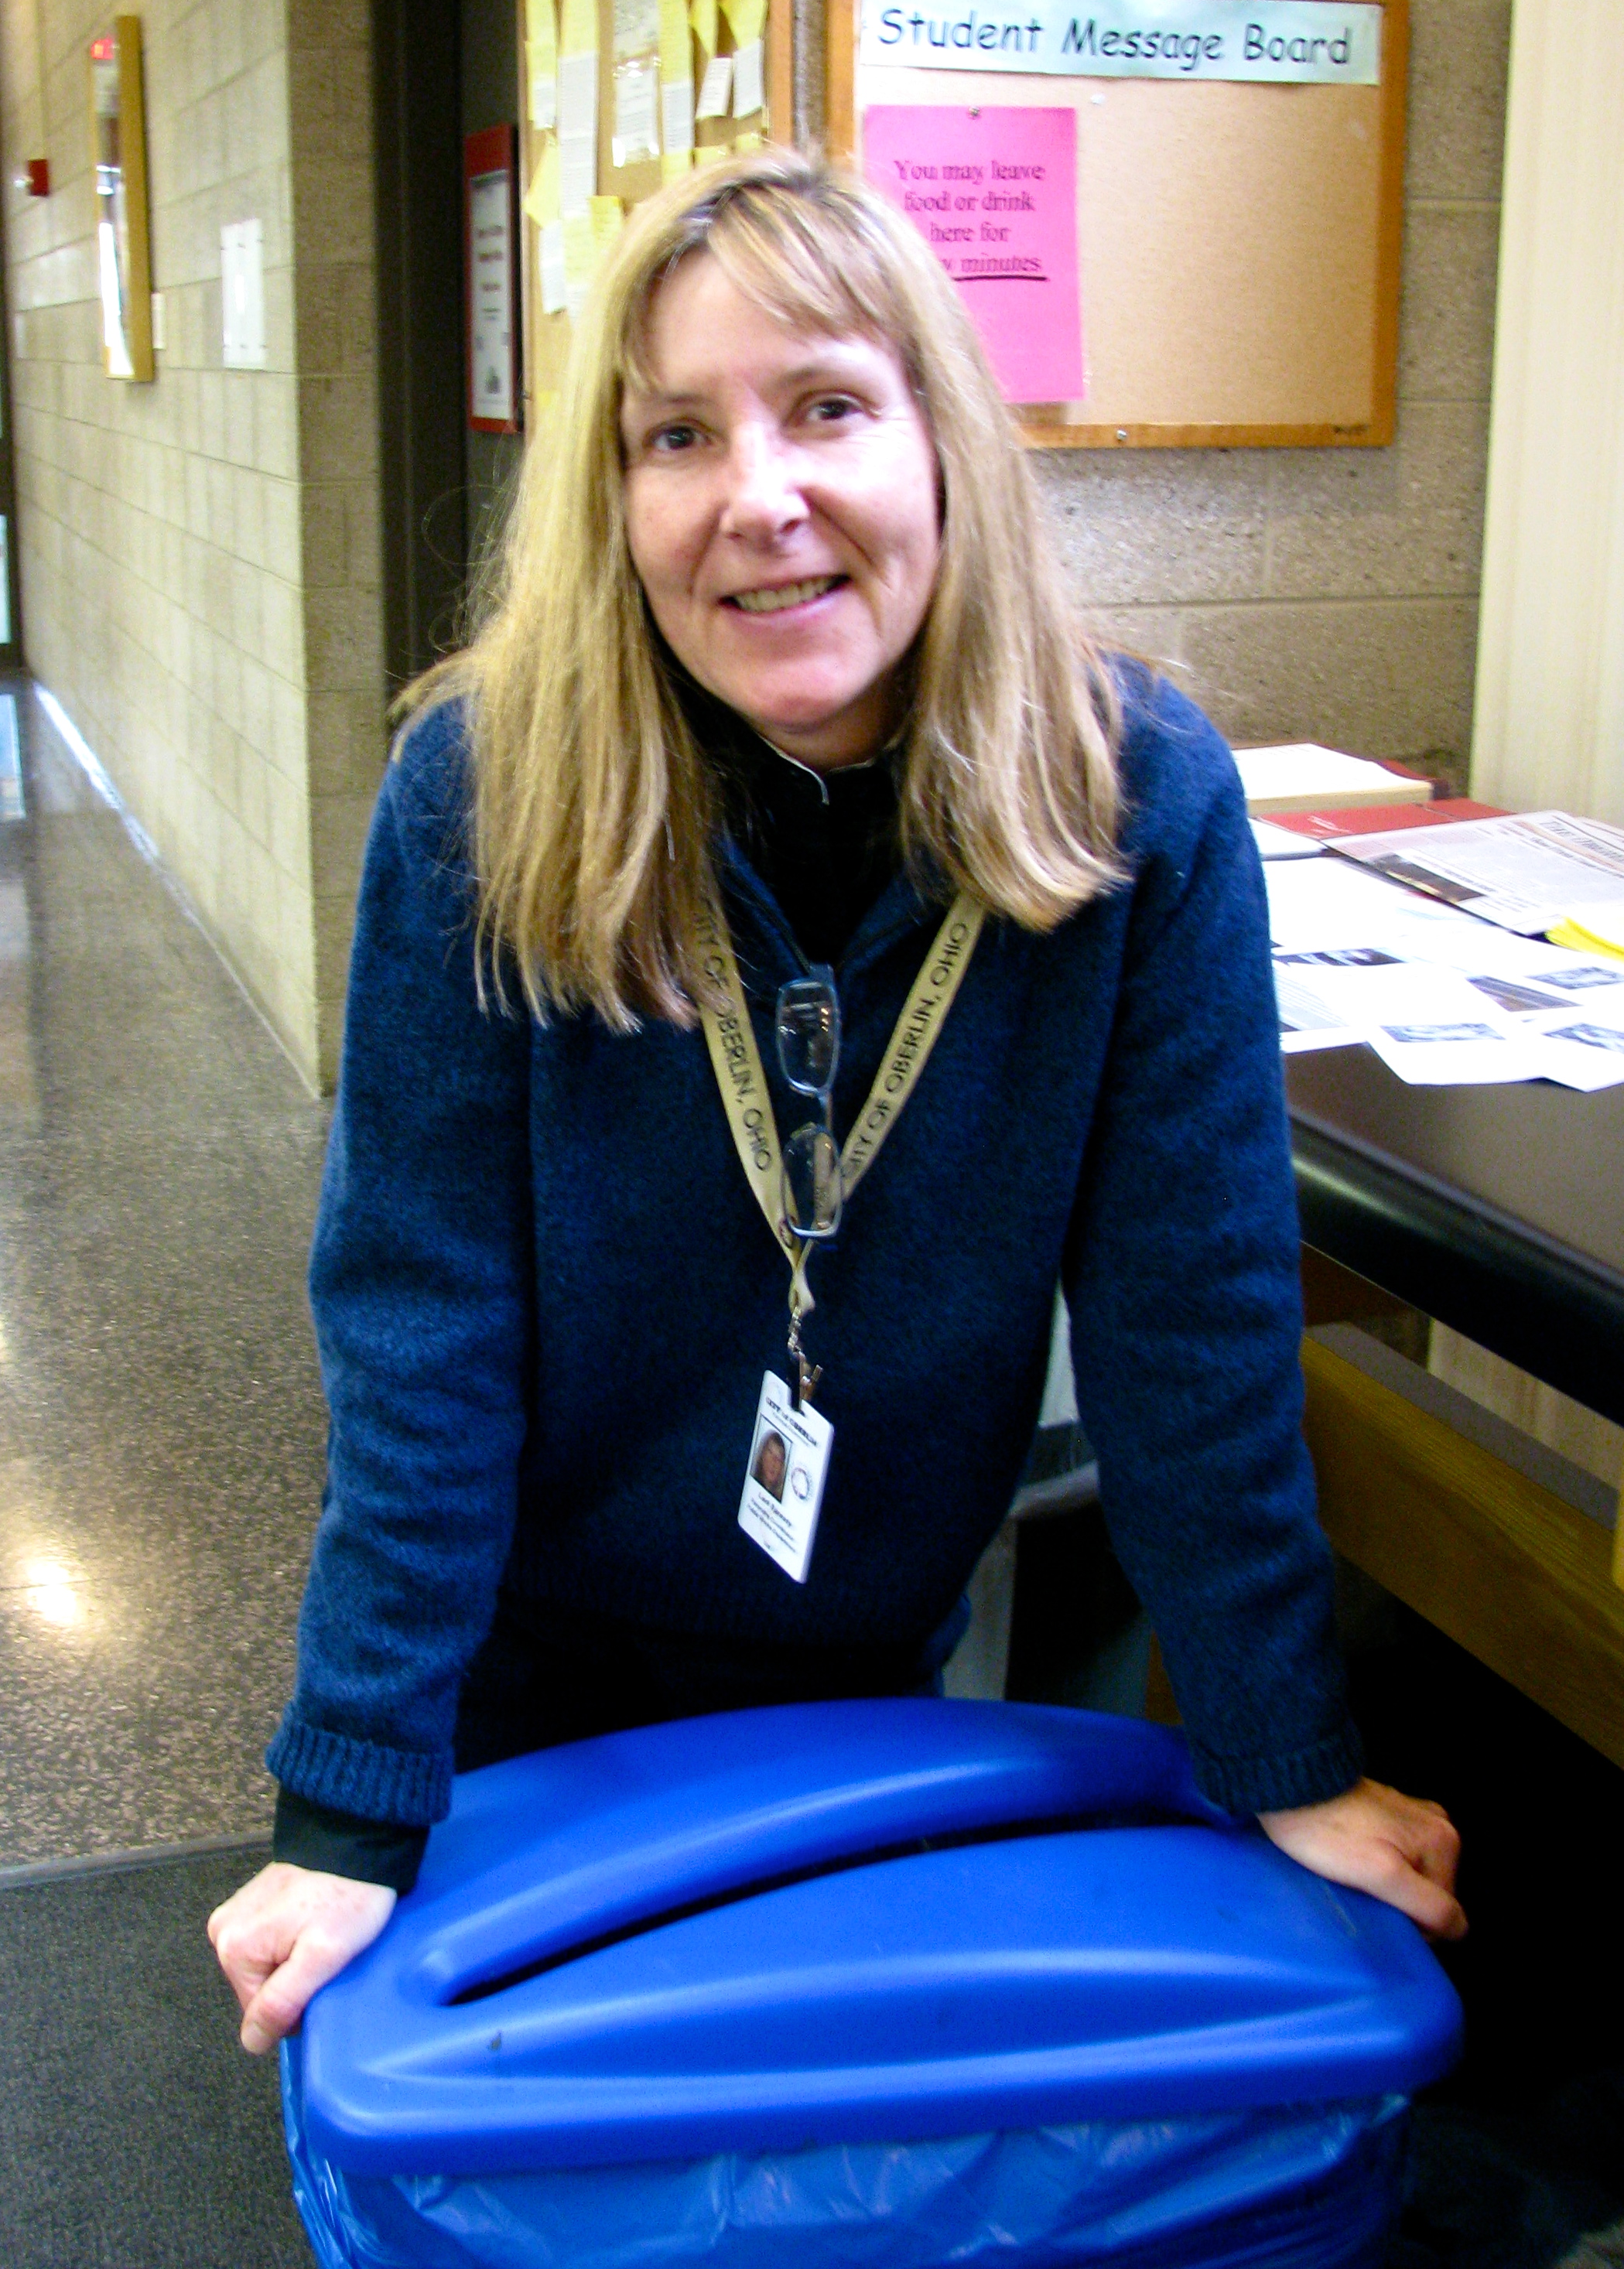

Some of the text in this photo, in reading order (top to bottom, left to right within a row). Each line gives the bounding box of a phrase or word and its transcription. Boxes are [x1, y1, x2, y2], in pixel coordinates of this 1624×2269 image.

[877, 8, 1350, 71] Student Message Board
[894, 159, 1045, 185] You may leave
[904, 191, 1035, 211] food or drink
[931, 221, 1010, 242] here for
[961, 252, 1041, 272] minutes
[867, 1099, 891, 1129] OF
[884, 995, 942, 1094] OBERLIN,
[930, 922, 969, 986] OHIO
[743, 1108, 771, 1171] OHIO
